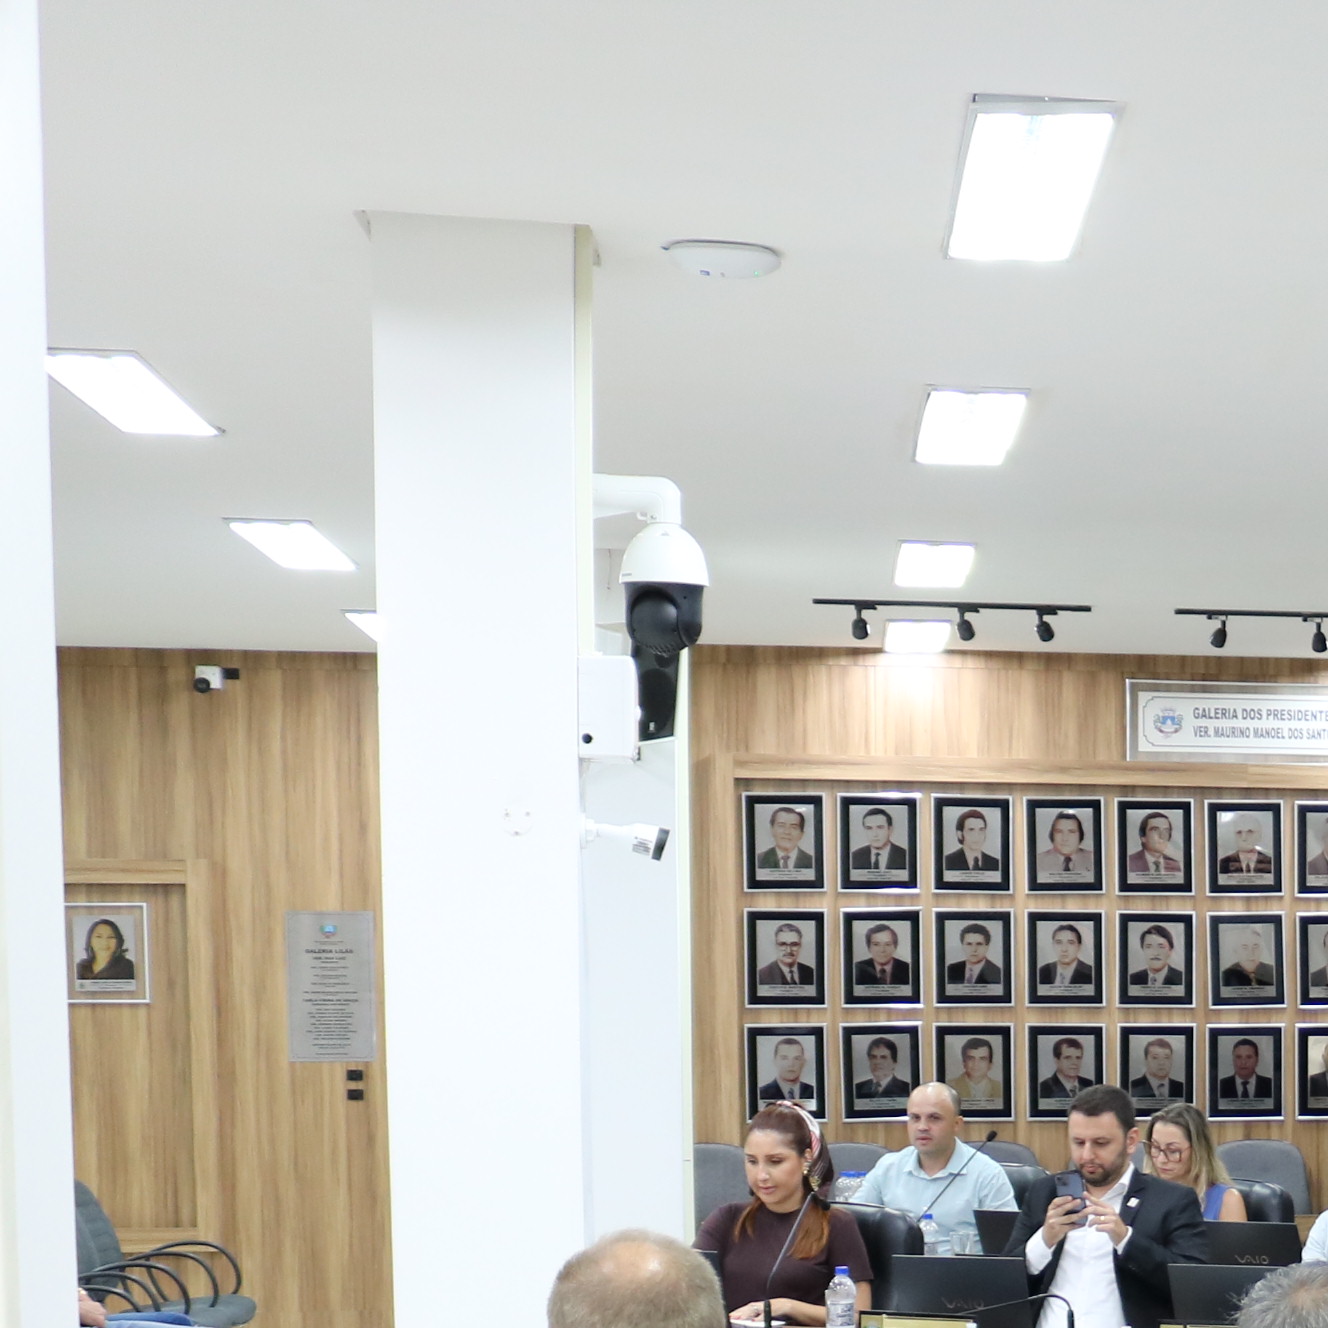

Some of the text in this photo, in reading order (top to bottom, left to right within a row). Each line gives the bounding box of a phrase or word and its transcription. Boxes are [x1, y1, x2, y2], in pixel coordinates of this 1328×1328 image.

[1193, 707, 1238, 720] GALERIA
[1241, 708, 1263, 720] DOS
[1193, 726, 1211, 738] VER.
[1213, 726, 1250, 738] MAURINO
[1253, 727, 1285, 739] MANOEL
[1288, 728, 1303, 740] DOS
[1235, 1255, 1270, 1264] VAIO
